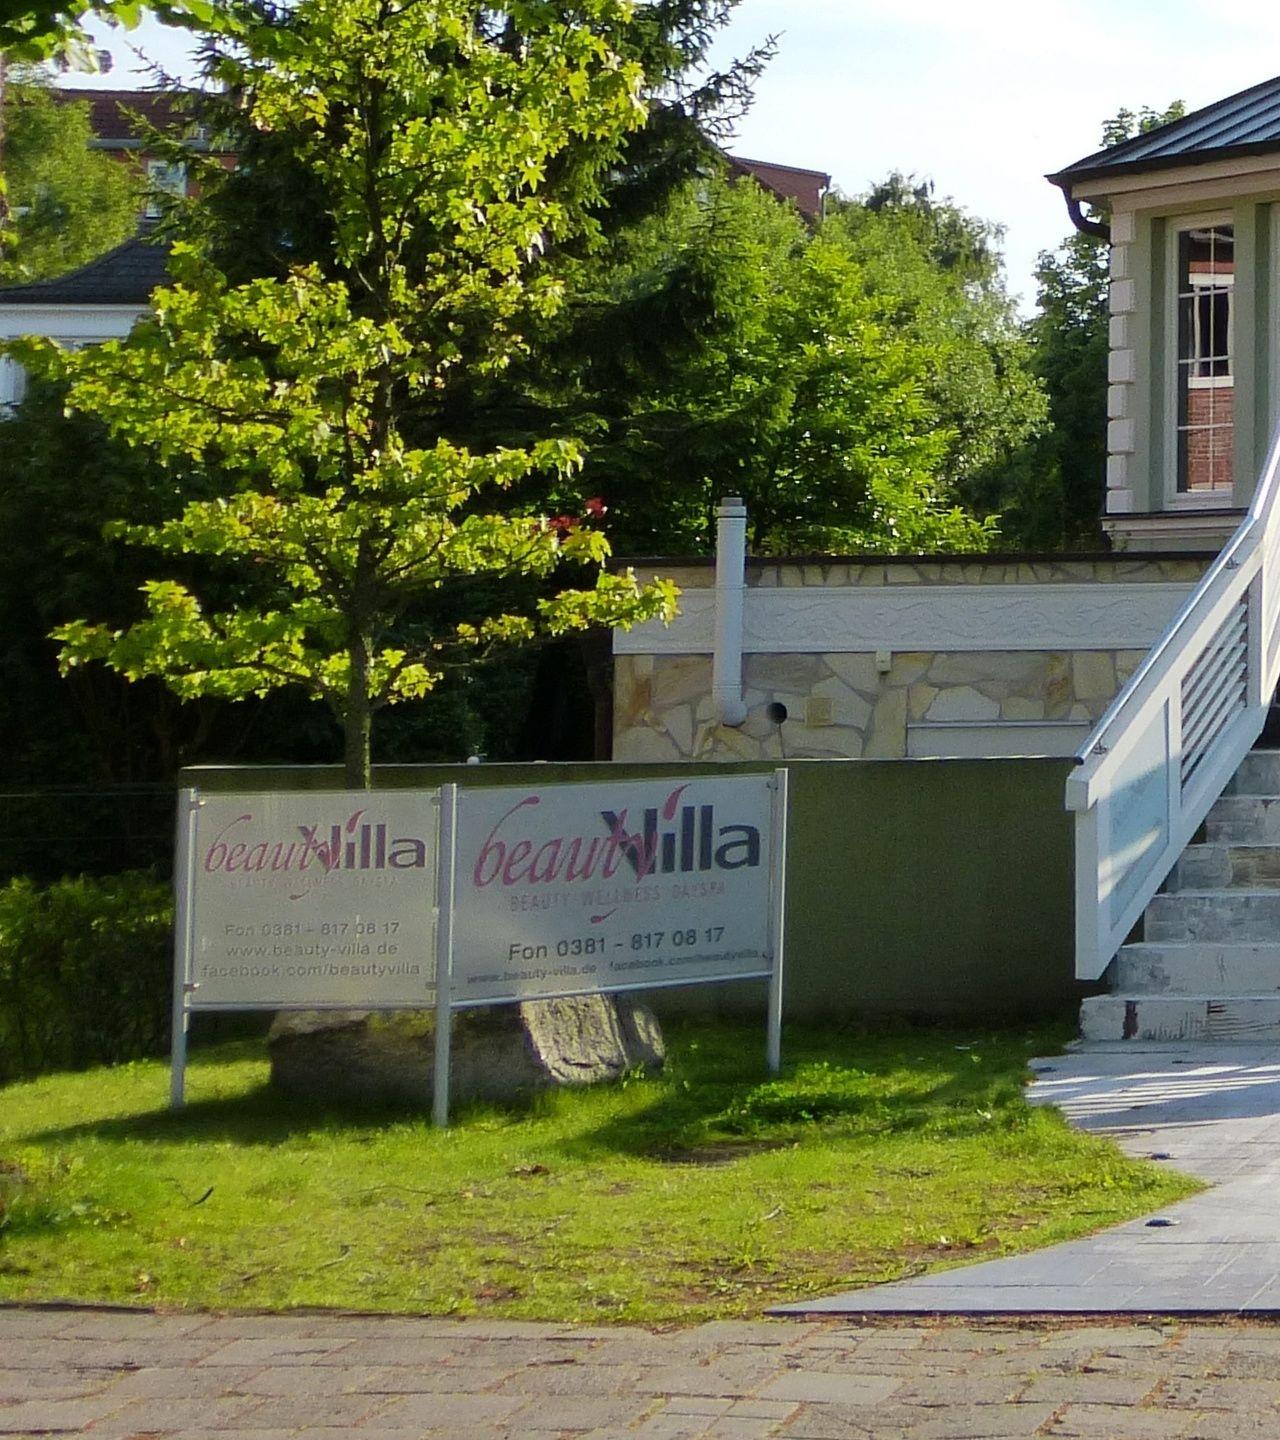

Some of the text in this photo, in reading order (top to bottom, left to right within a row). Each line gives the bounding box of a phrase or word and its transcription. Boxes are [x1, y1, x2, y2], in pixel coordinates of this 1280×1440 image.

[224, 923, 255, 937] Fon
[261, 923, 300, 937] 0381
[320, 922, 349, 936] 817
[356, 922, 377, 935] 08
[383, 921, 400, 935] 17
[508, 943, 548, 961] Fon
[556, 937, 606, 957] 0381
[630, 931, 665, 950] 817
[672, 929, 698, 947] 08
[704, 926, 725, 944] 17
